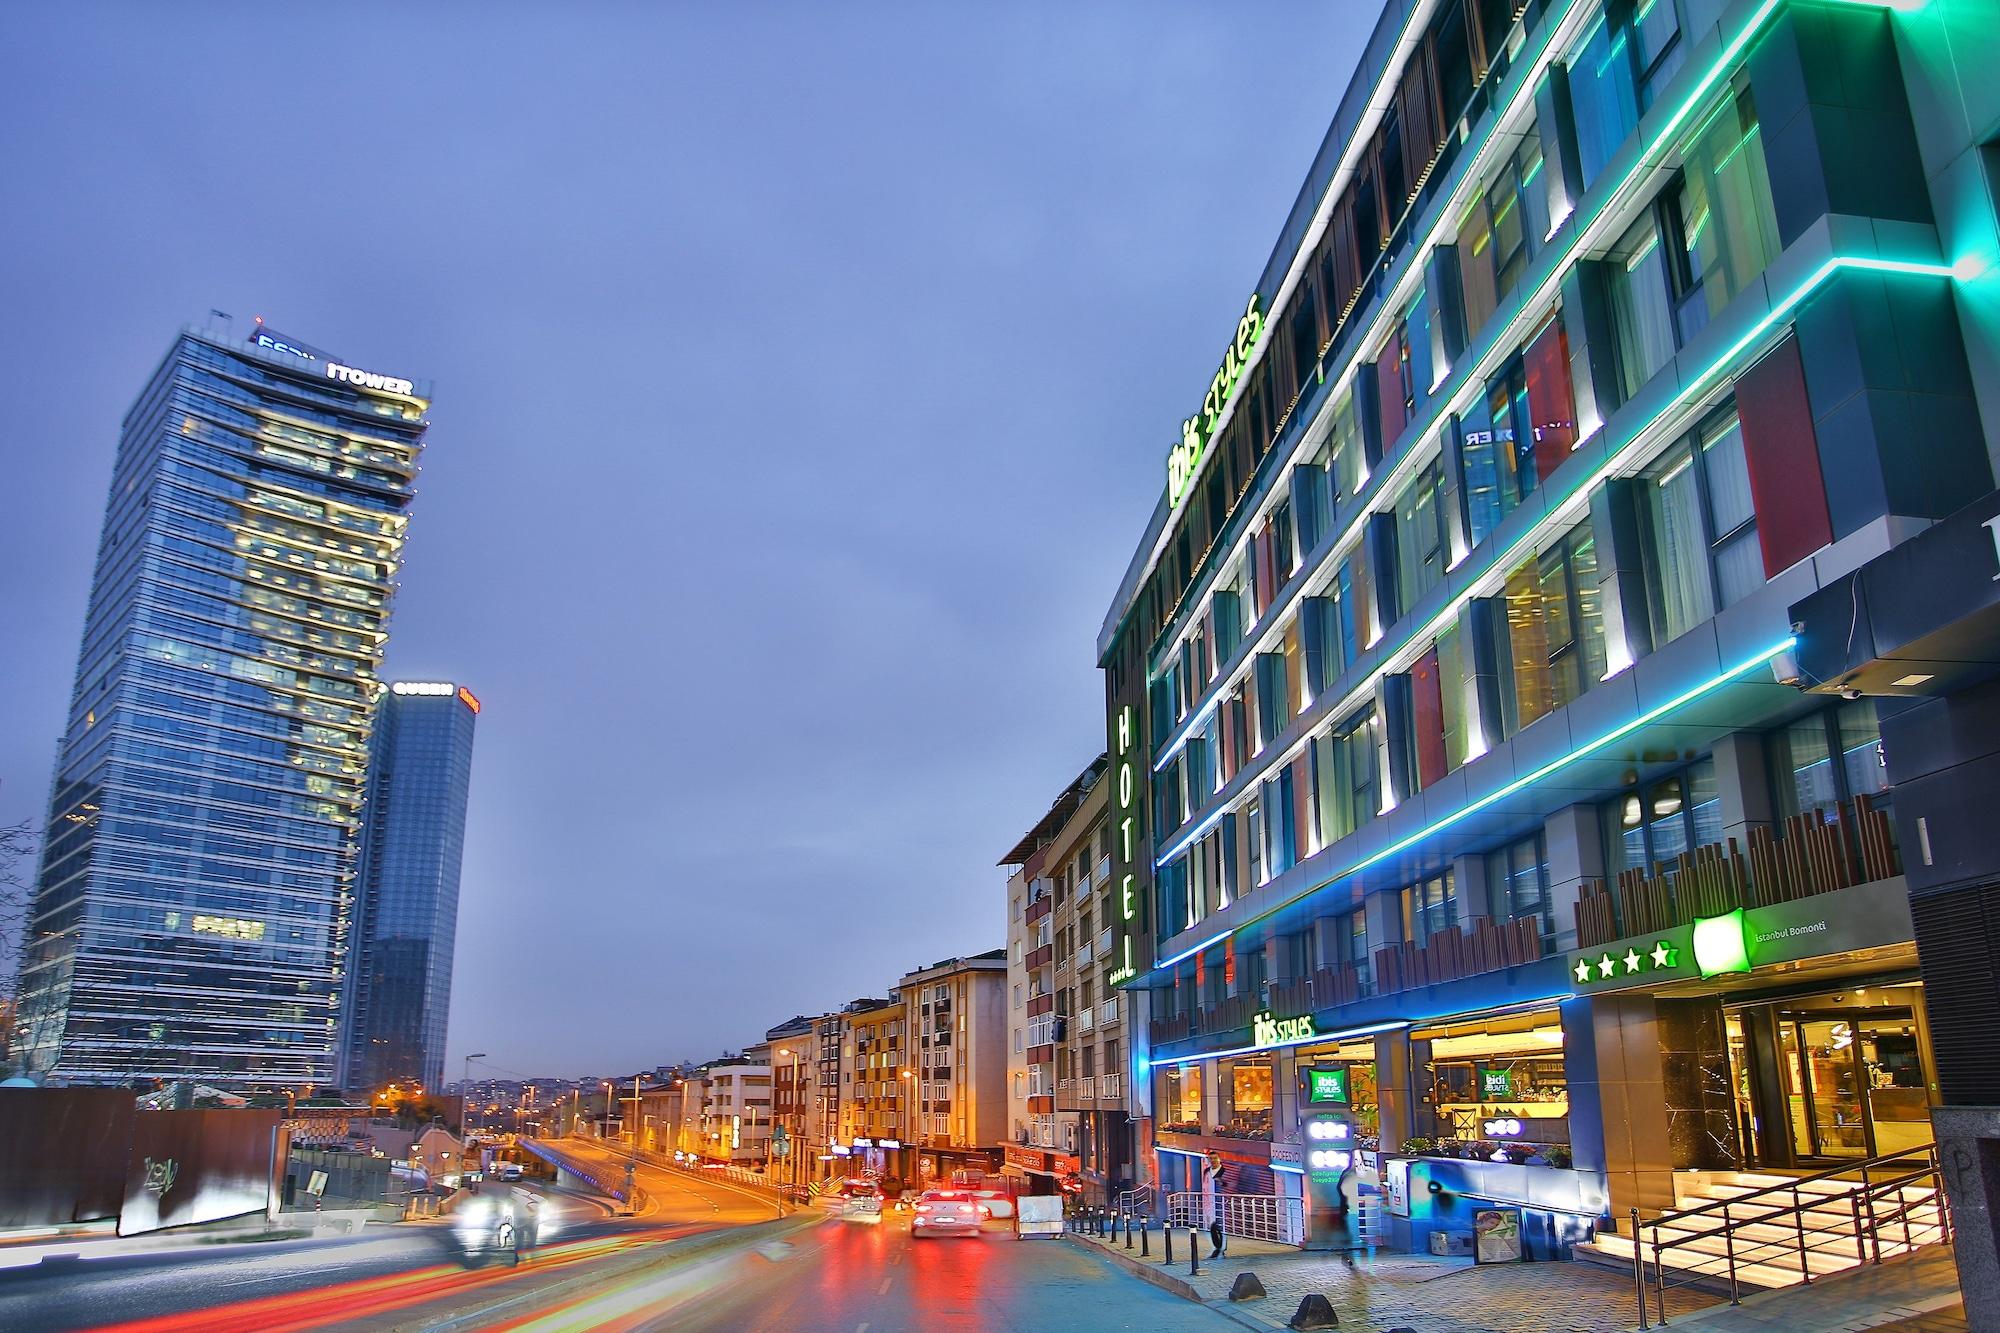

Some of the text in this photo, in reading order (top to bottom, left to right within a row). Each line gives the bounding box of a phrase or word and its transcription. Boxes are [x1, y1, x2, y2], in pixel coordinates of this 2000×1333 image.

[1168, 414, 1202, 509] ibis
[1118, 705, 1134, 978] HOTEL
[1789, 920, 1826, 936] Bomonti
[1254, 1012, 1277, 1046] ibis
[1318, 1076, 1338, 1087] ibis
